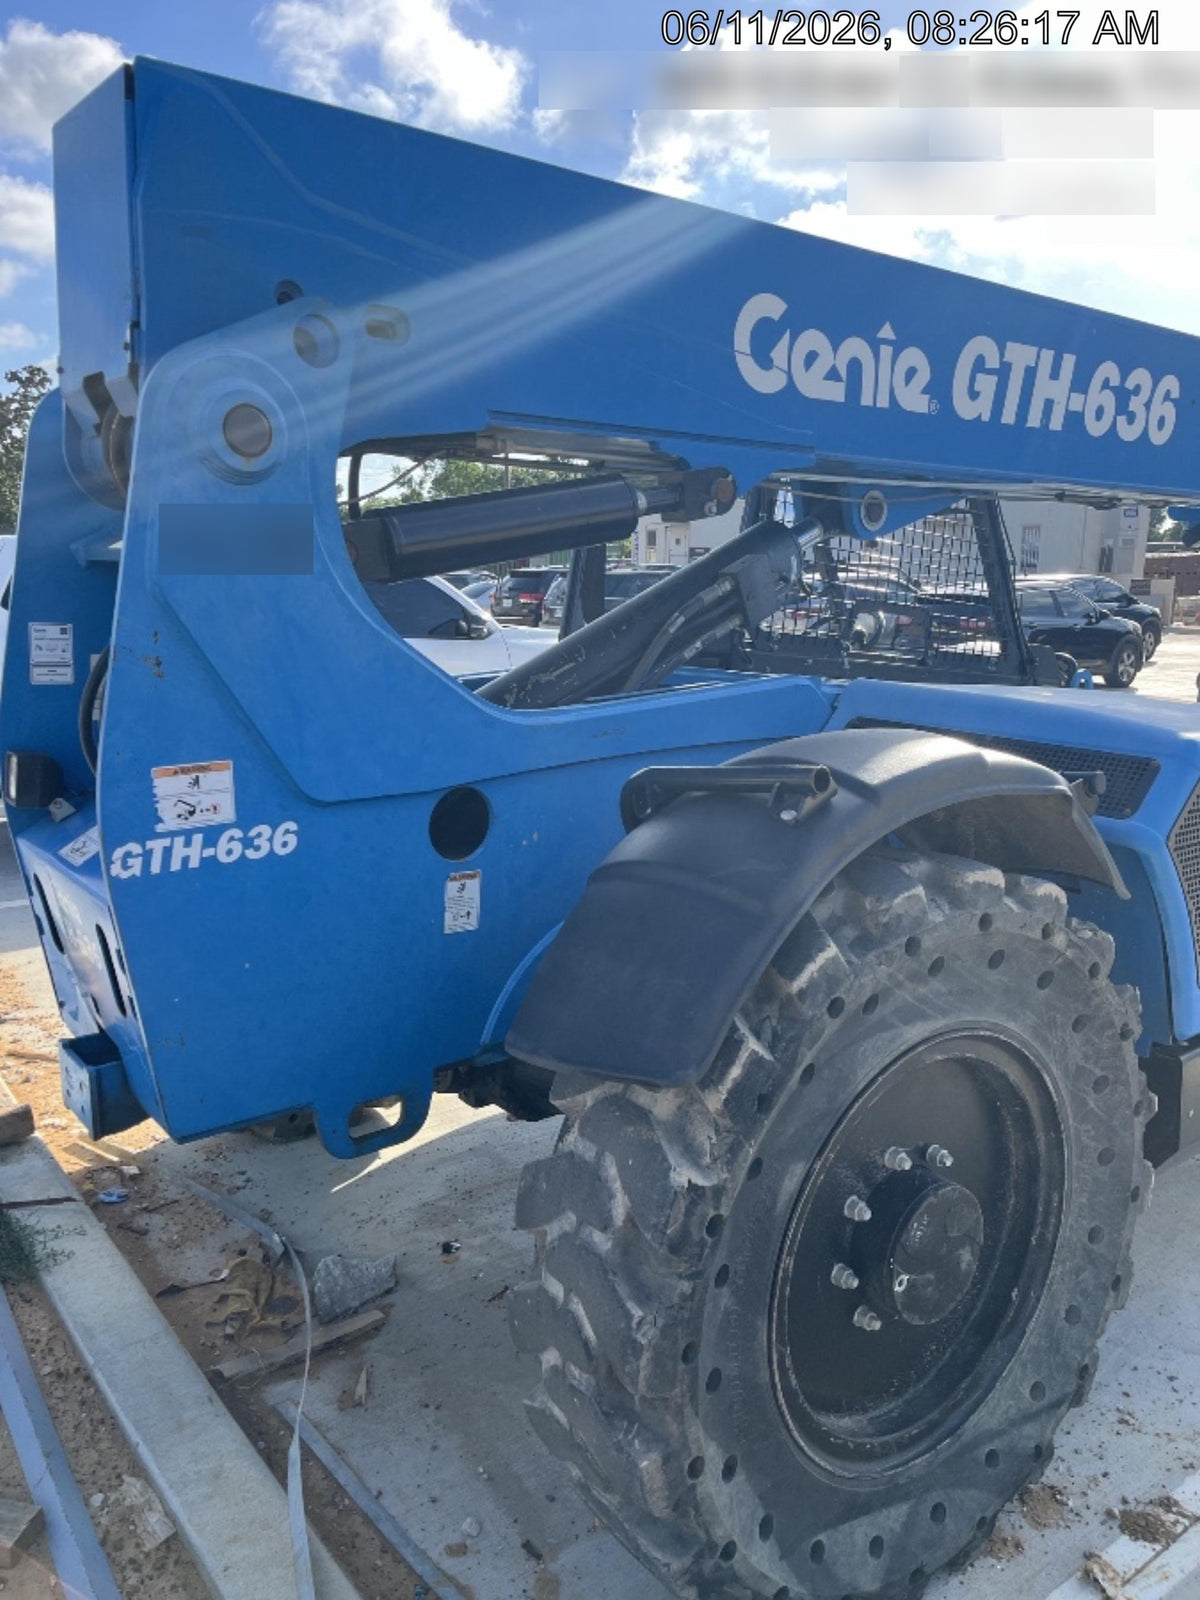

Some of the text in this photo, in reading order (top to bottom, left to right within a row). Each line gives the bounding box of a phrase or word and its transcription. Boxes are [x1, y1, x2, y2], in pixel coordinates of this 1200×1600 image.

[733, 292, 1181, 446] Genie GTH-636
[109, 821, 299, 880] GTH-636
